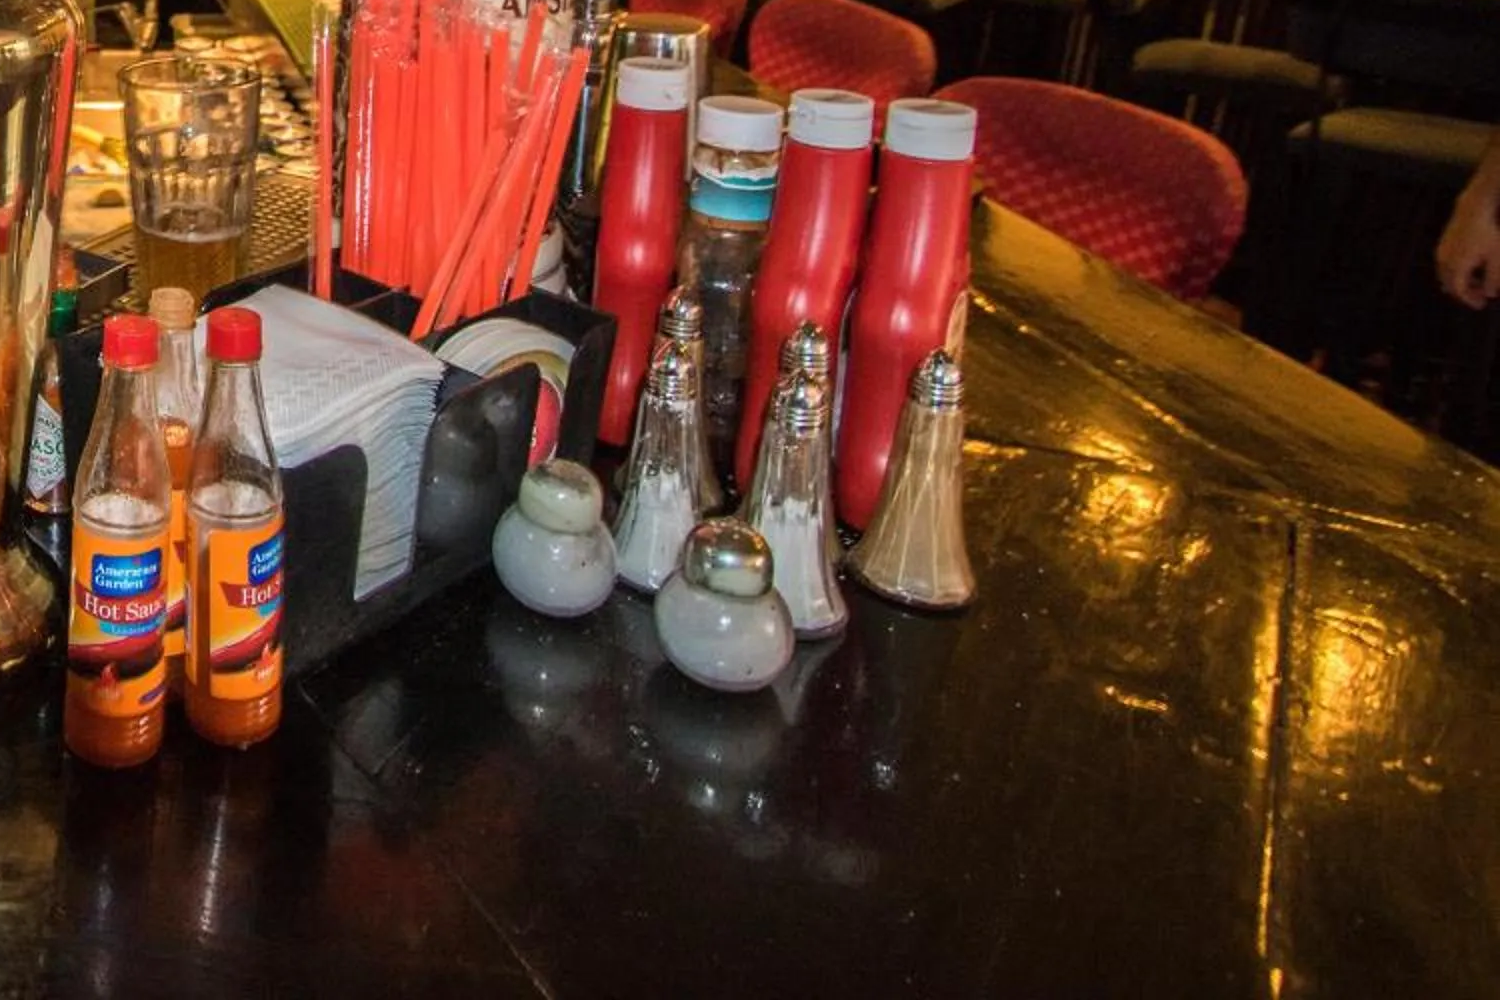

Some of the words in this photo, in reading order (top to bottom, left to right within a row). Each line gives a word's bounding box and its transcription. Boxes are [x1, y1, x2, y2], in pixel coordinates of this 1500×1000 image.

[95, 561, 158, 578] American
[95, 574, 144, 590] Garden
[241, 584, 272, 606] Hot
[84, 591, 121, 621] Hot
